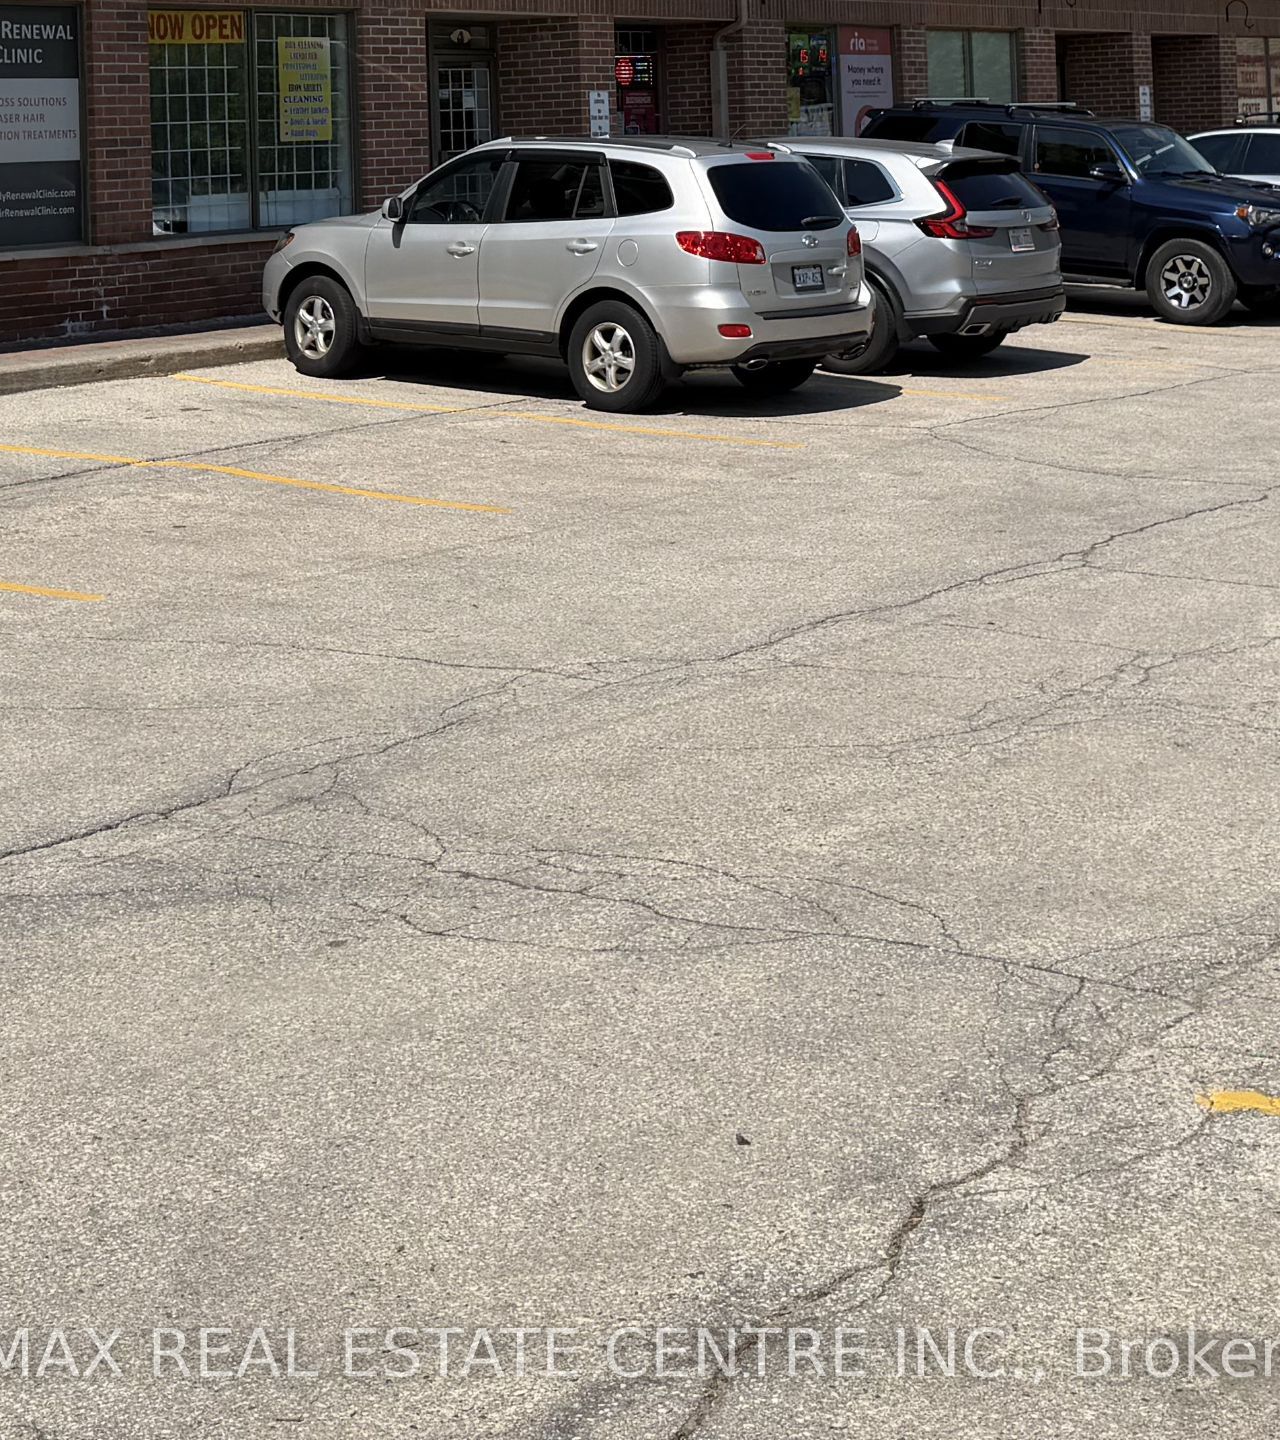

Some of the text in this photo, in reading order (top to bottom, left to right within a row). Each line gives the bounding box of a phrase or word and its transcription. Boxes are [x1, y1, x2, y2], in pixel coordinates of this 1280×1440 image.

[150, 13, 242, 41] NOW OPEN
[850, 31, 866, 51] ria
[847, 65, 884, 76] Money where
[851, 78, 862, 88] you
[863, 78, 876, 86] need
[17, 96, 67, 107] SOLUTIONS
[283, 95, 324, 103] CLEANING
[23, 113, 46, 123] HAIR
[22, 128, 77, 141] TREATMENTS
